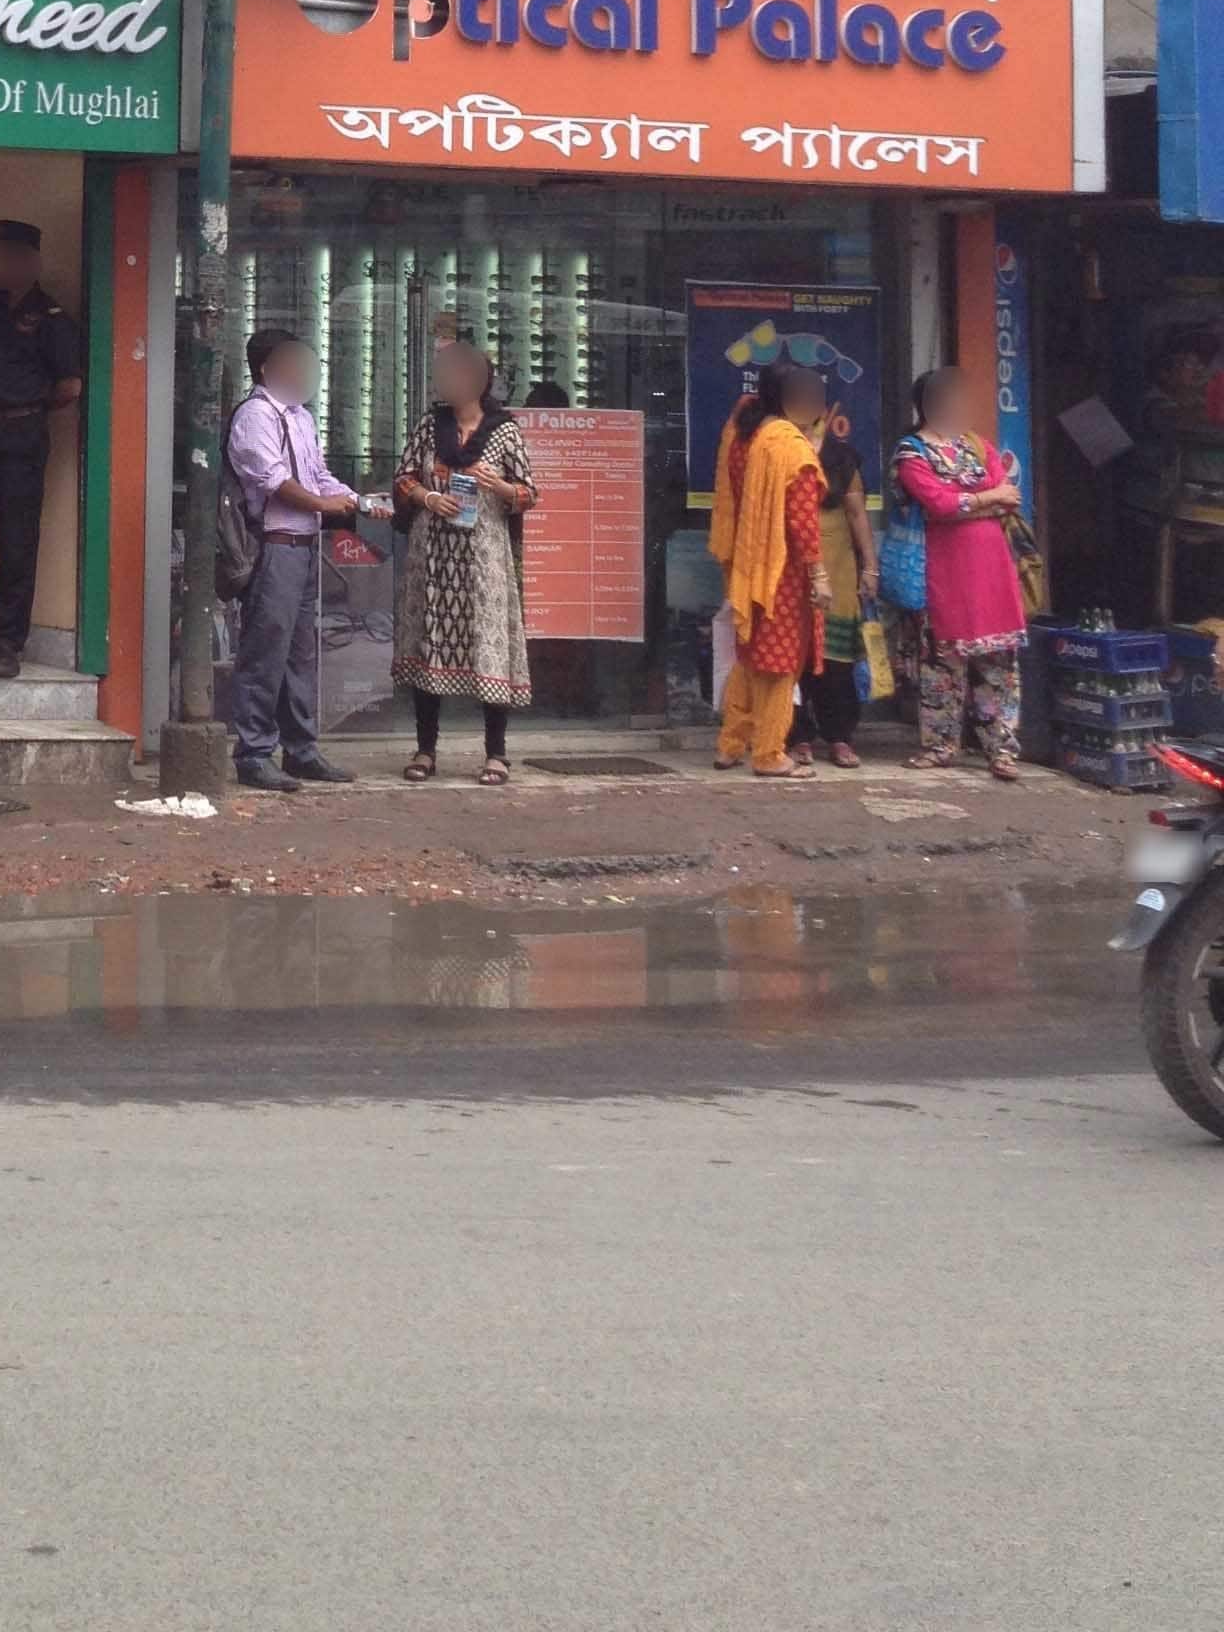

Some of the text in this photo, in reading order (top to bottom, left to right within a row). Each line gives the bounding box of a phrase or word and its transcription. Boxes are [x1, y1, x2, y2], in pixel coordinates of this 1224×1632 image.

[34, 79, 161, 124] Mughlai
[319, 93, 988, 176] অপটিক্যাল প্যালেস
[996, 292, 1019, 413] pepsi
[539, 413, 596, 429] Palace
